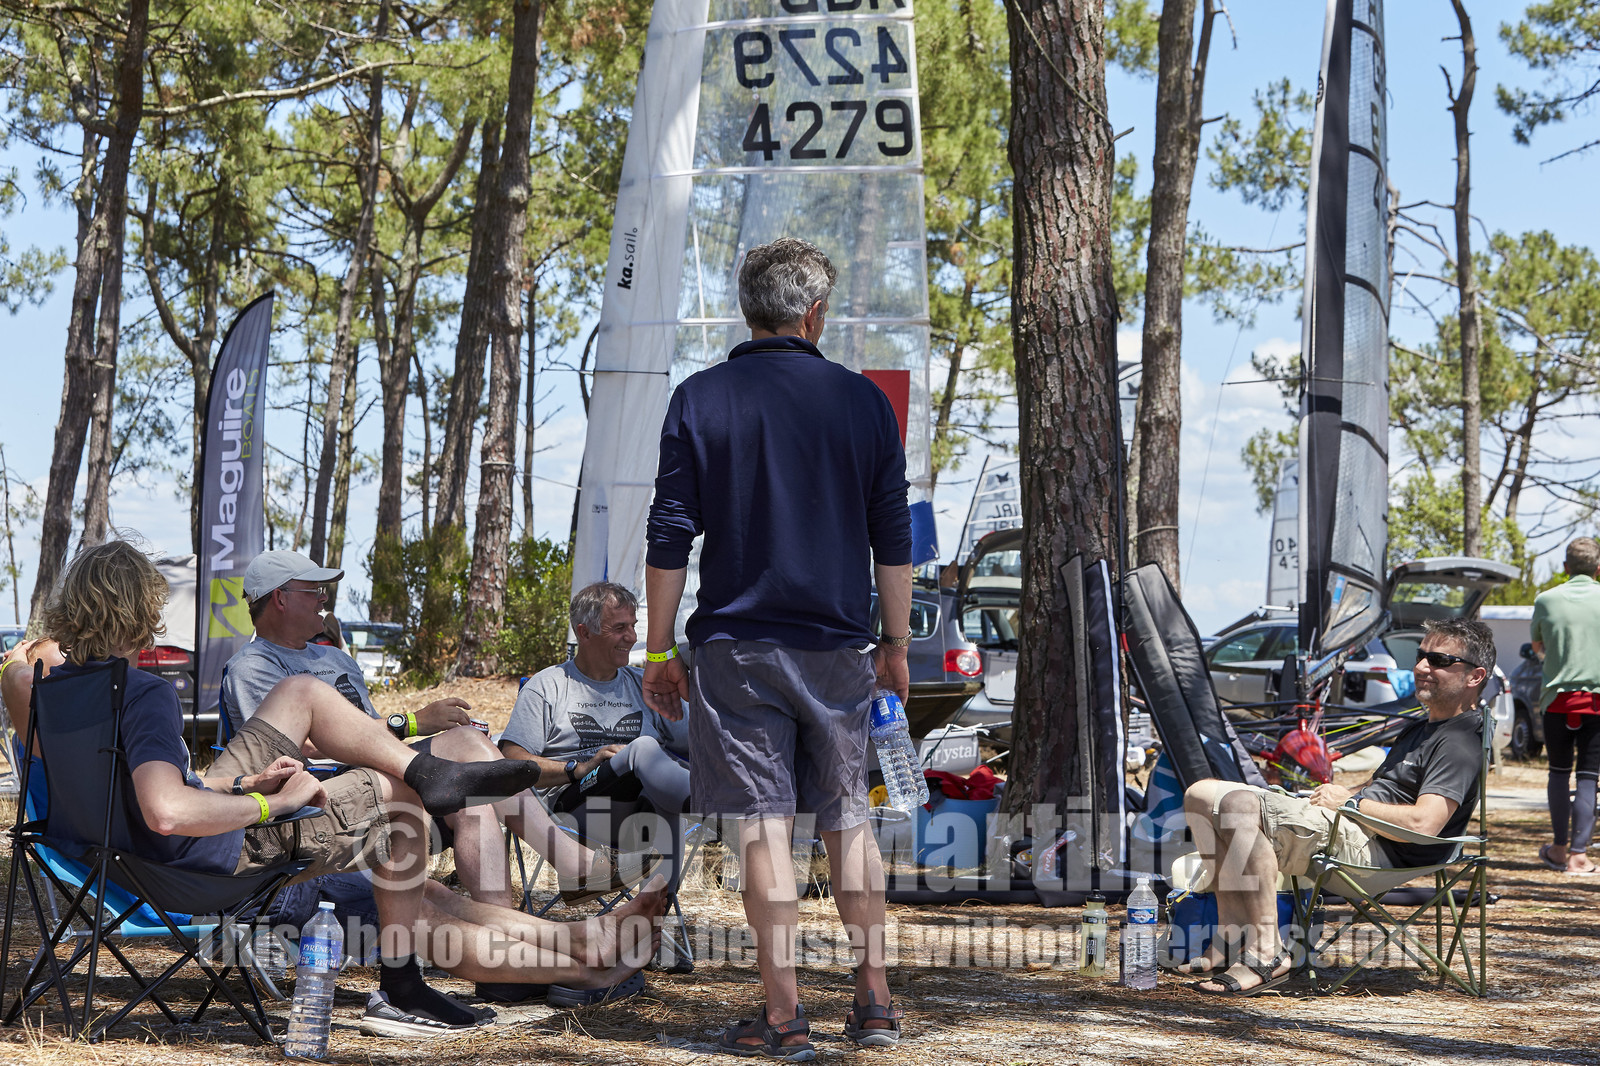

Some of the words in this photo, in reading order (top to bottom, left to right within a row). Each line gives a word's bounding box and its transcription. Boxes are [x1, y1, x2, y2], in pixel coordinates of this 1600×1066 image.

[742, 99, 913, 161] 4279
[241, 368, 260, 459] BOATS
[211, 367, 247, 571] Maguire
[576, 701, 598, 709] Types
[598, 700, 607, 708] of
[923, 741, 978, 764] Crystal
